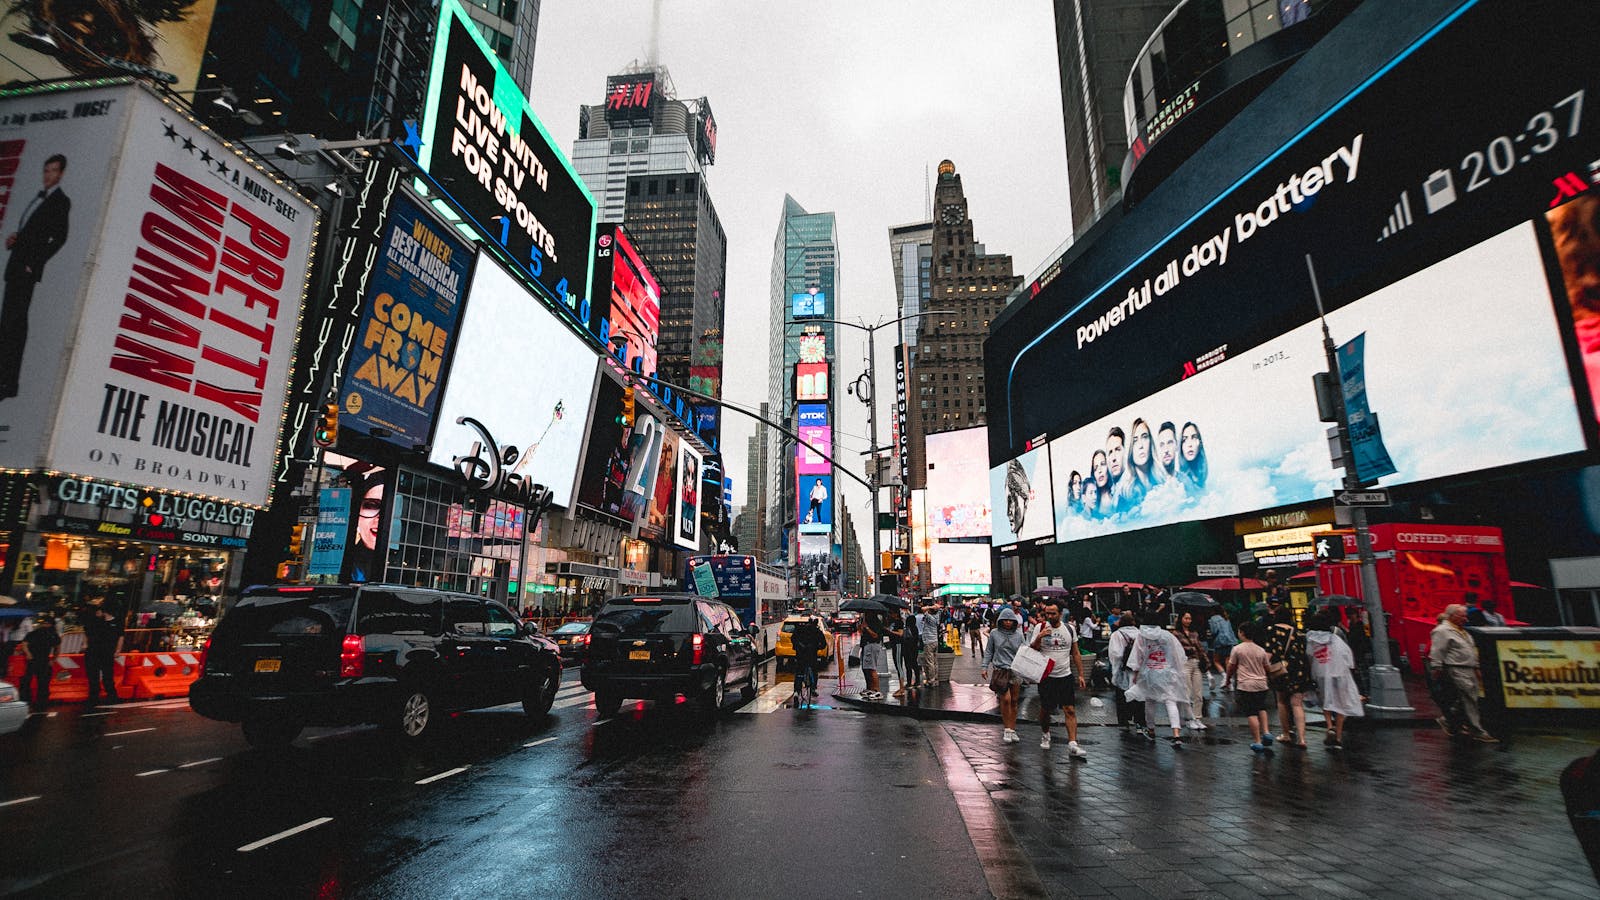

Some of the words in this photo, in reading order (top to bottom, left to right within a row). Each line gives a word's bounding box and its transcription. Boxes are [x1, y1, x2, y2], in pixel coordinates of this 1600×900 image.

[607, 81, 653, 110] H&M
[1146, 81, 1200, 135] MARRIOTT
[1148, 97, 1196, 145] MARQUIS
[455, 95, 499, 166] LIVE
[502, 148, 525, 190] TV
[460, 63, 506, 136] NOW
[509, 126, 549, 192] WITH
[1460, 88, 1585, 193] 20:37
[231, 168, 240, 186] A
[242, 177, 298, 223] MUST-SEE!
[451, 127, 492, 194] FOR
[494, 177, 558, 264] SPORTS.
[390, 225, 420, 262] BEST
[418, 247, 460, 295] MUSICAL
[413, 218, 453, 266] WINNER!
[598, 249, 610, 257] LG
[1076, 279, 1152, 350] Powerful
[1154, 259, 1180, 297] all
[1182, 226, 1231, 278] day
[1234, 133, 1364, 244] battery
[109, 161, 229, 394] WOMAN
[386, 246, 398, 263] ALL
[398, 253, 421, 278] ACROSS
[420, 271, 437, 290] NORTH
[436, 282, 457, 305] AMERICA
[194, 201, 291, 424] PRETTY
[373, 292, 448, 358] COME
[353, 353, 437, 409] AWAY
[97, 383, 150, 442] THE
[152, 400, 256, 468] MUSICAL
[896, 360, 908, 477] COMMUNICATE
[89, 449, 123, 466] ON
[134, 458, 250, 491] BROADWAY
[624, 413, 666, 501] 21
[58, 478, 140, 510] GIFTS
[158, 494, 256, 528] LUGGAGE
[97, 522, 131, 536] Nikon
[163, 515, 187, 530] NY
[1262, 510, 1309, 529] INVICTA
[182, 532, 219, 545] SONY
[316, 531, 336, 539] DEAR
[17, 552, 31, 581] ATM
